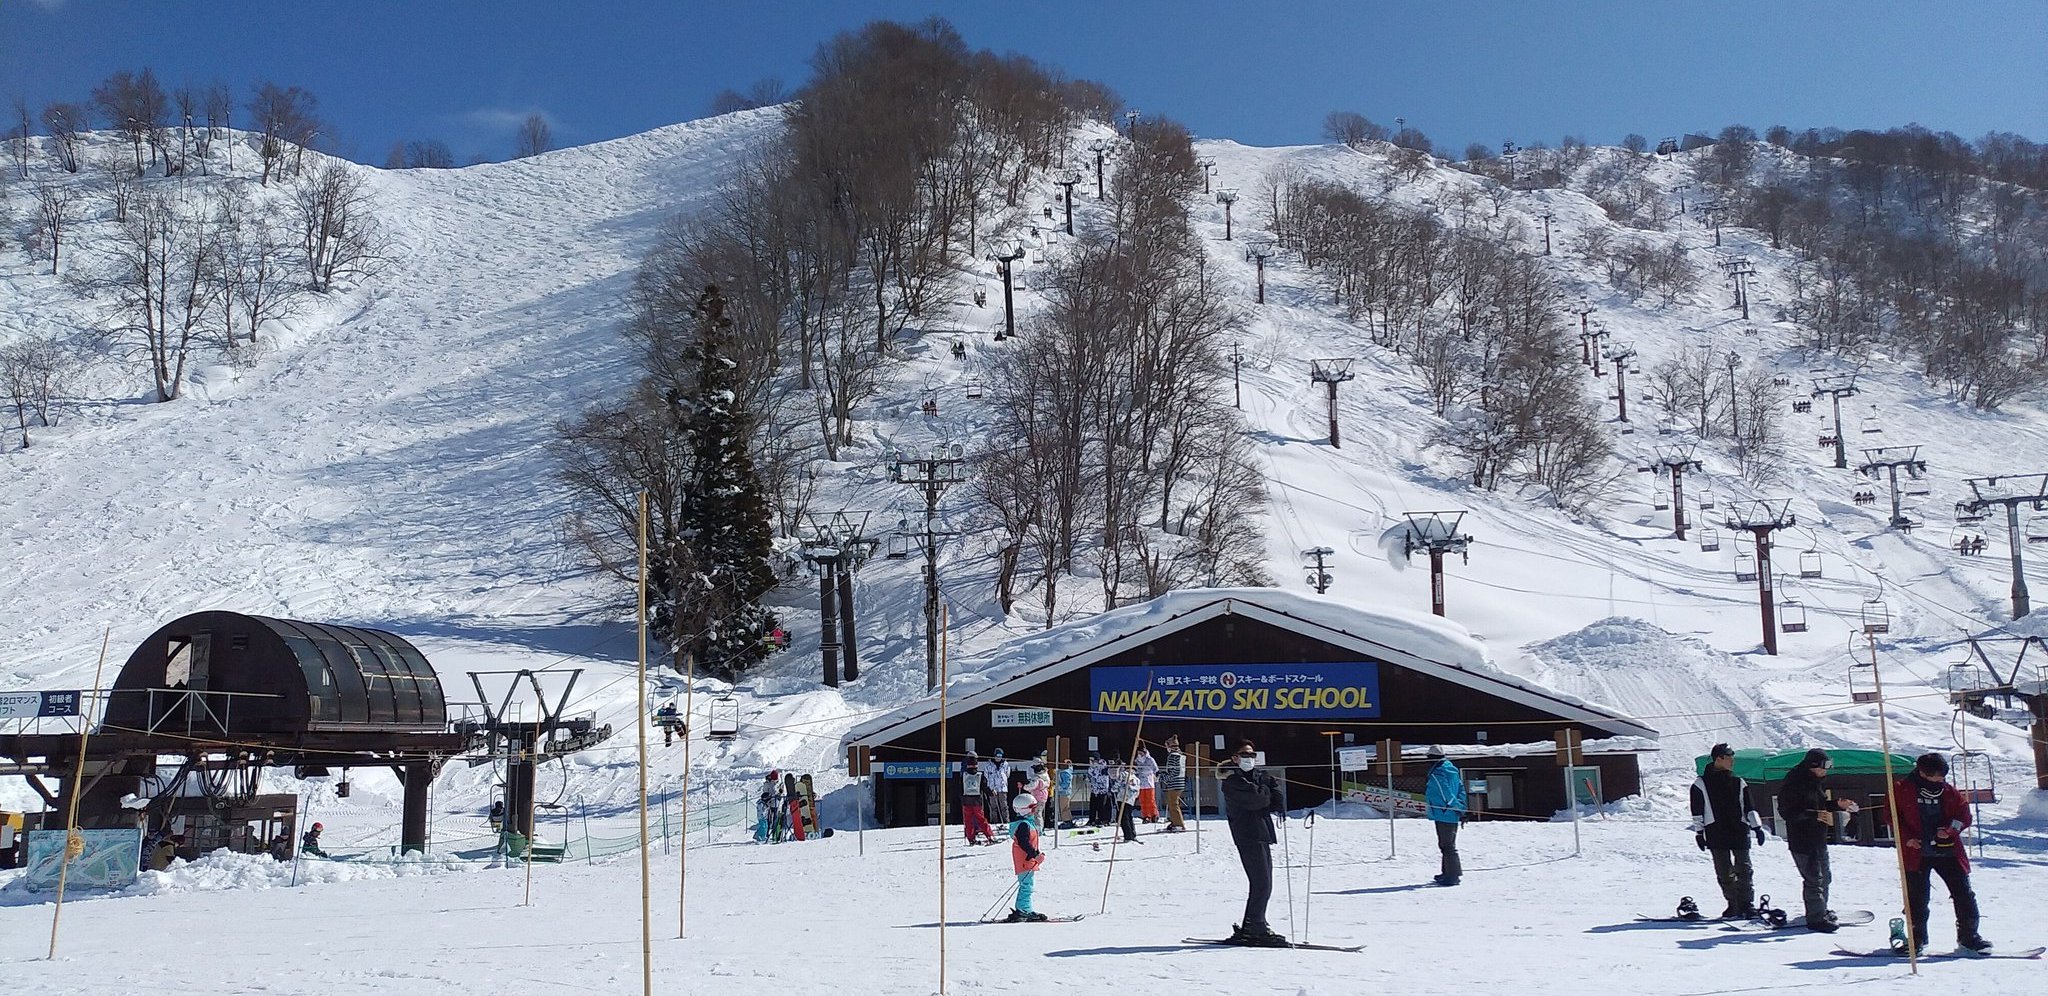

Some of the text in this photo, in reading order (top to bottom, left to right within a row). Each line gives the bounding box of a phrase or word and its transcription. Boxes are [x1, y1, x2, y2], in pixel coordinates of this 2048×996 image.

[1157, 675, 1217, 685] 中里スキー学校
[1237, 674, 1323, 684] スキー&ボードスクール
[48, 694, 73, 704] 初級者
[1098, 687, 1372, 712] NAKAZATO SKI SCHOOL
[48, 705, 72, 714] コース
